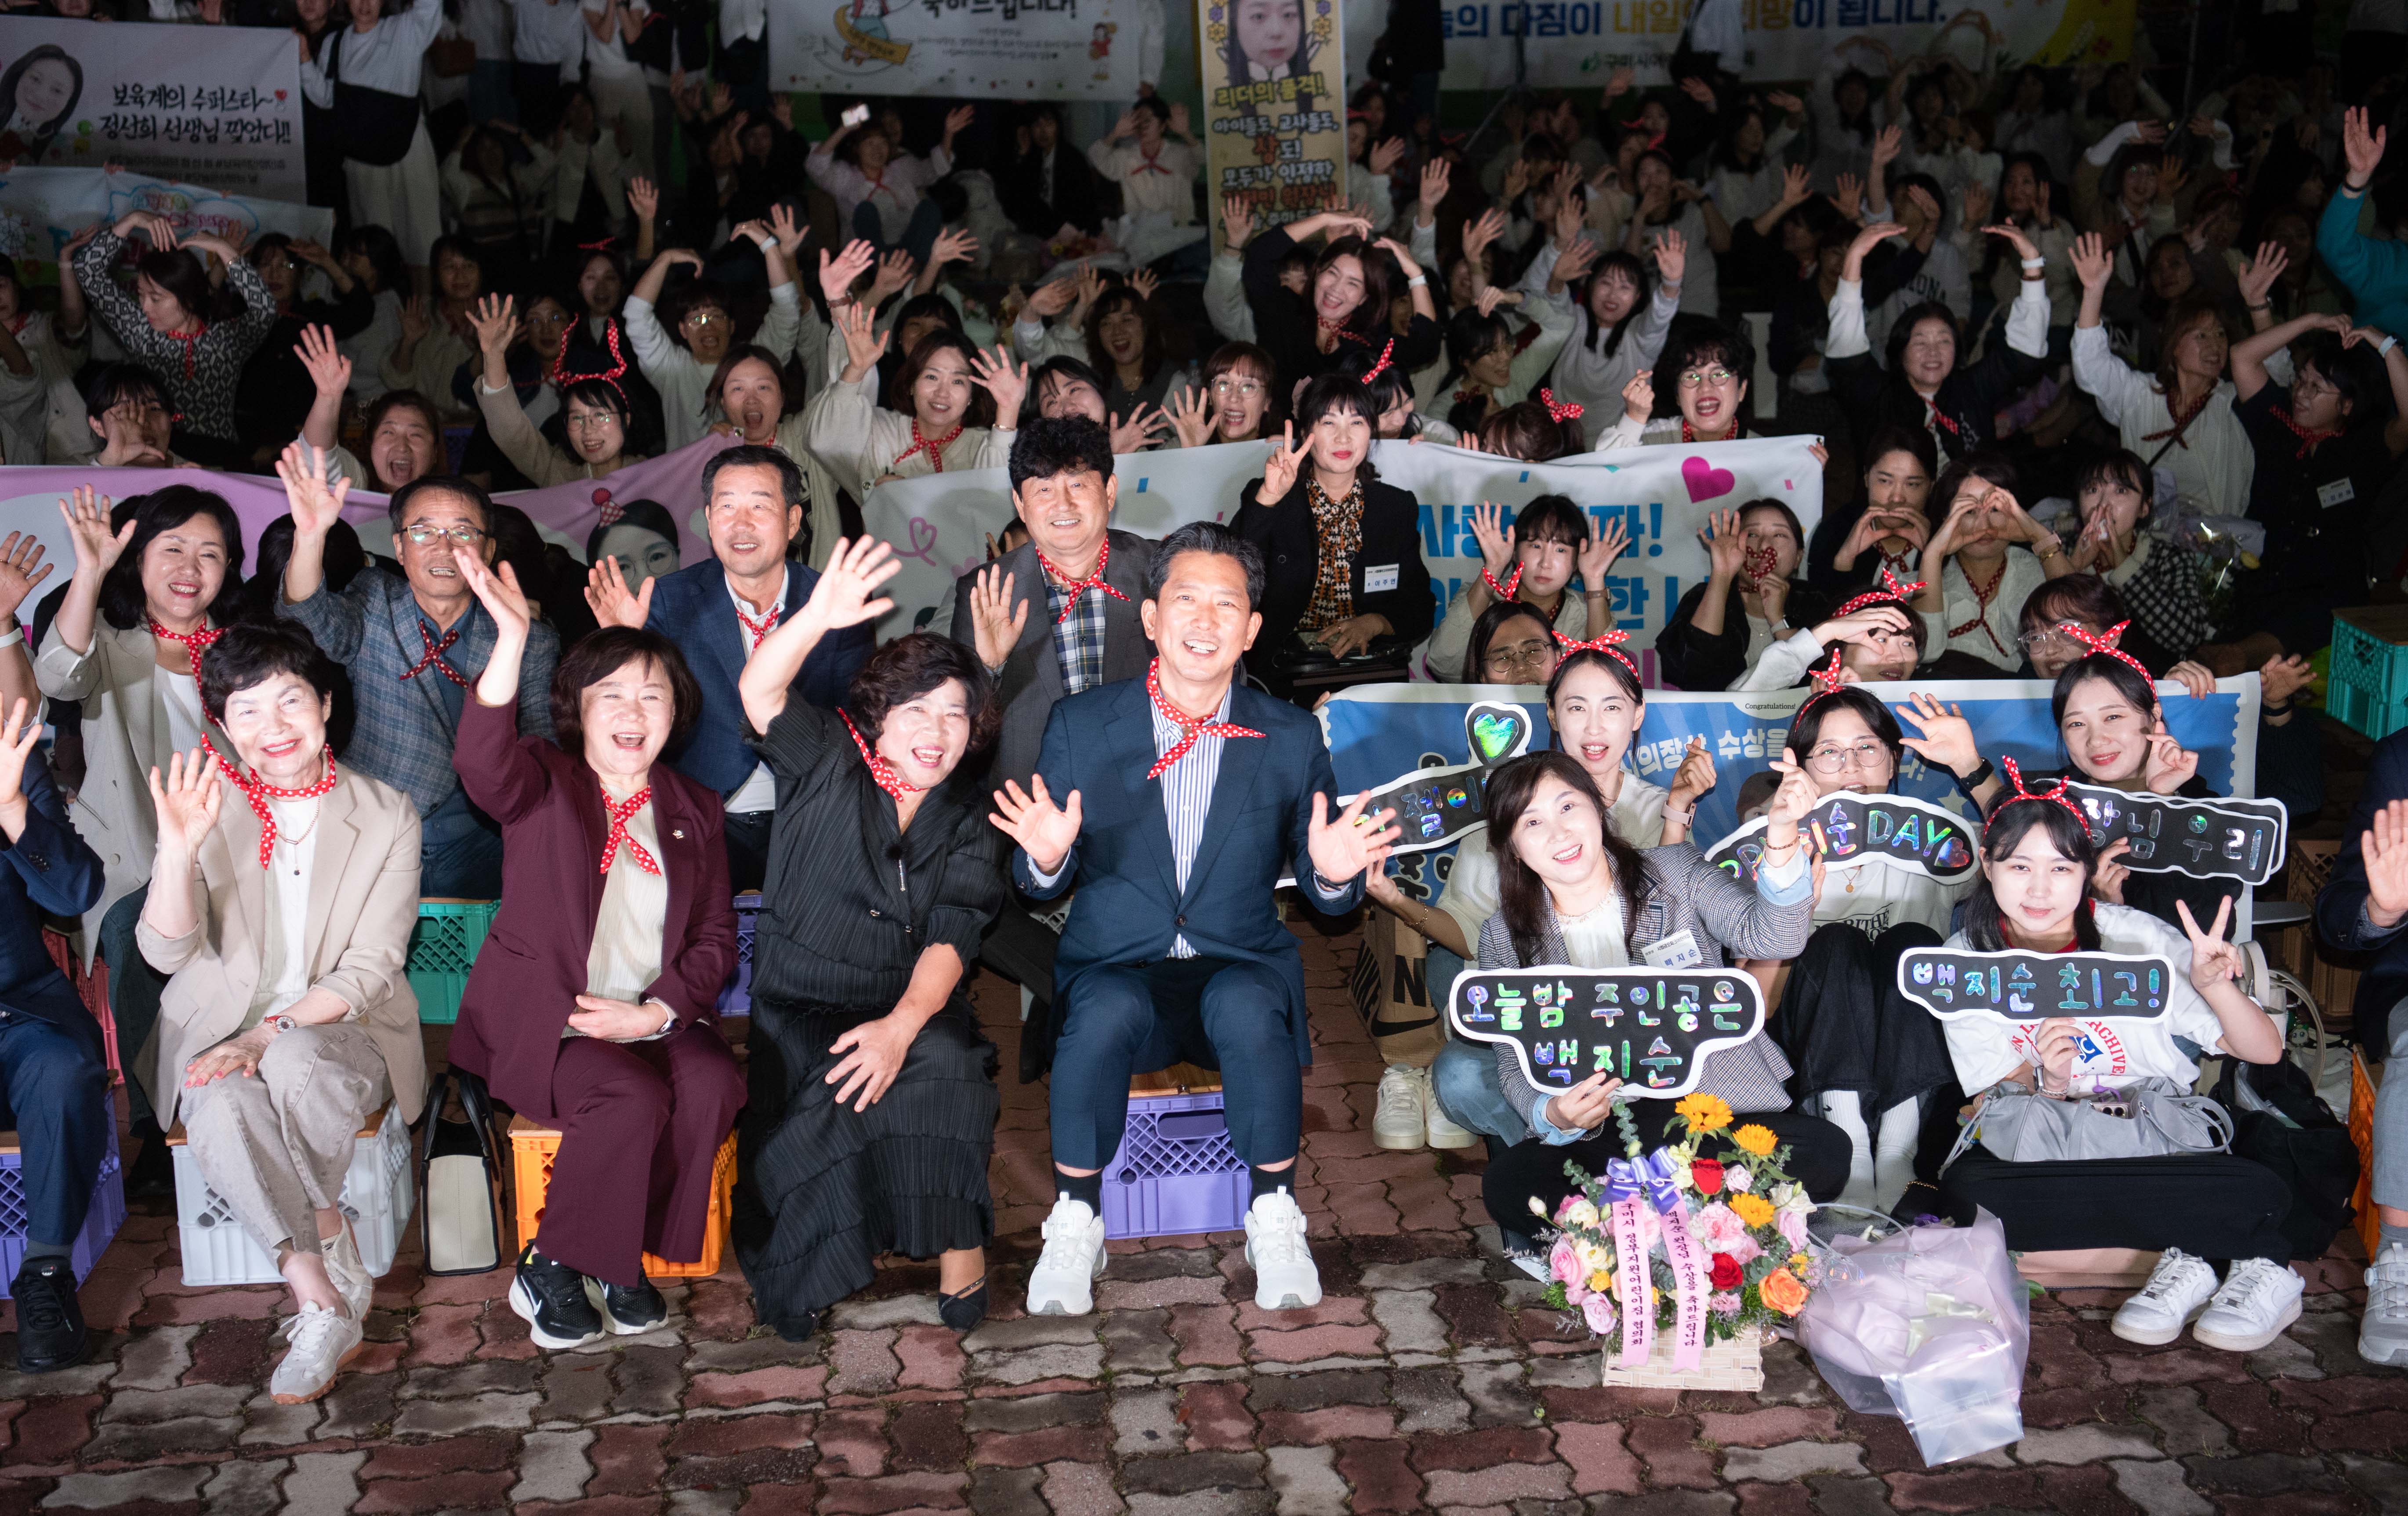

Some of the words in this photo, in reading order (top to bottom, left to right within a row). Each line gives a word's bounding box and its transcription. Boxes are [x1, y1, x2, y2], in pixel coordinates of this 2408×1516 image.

[113, 83, 185, 110] 보육계의
[1215, 81, 1275, 109] 리더의
[1279, 72, 1324, 102] 품격!
[100, 112, 157, 141] 정선희
[163, 115, 220, 143] 선생님
[1213, 115, 1277, 136] 아이들도,
[1279, 111, 1339, 133] 교사들도,
[1222, 164, 1274, 187] 모두가
[1277, 158, 1335, 185] 인정한
[1745, 702, 1796, 711] Congratulations!
[1718, 728, 1789, 760] 수상을
[1868, 809, 1952, 858] DAY
[2182, 813, 2263, 872] 우리
[1912, 962, 2037, 1013] 백지순
[2058, 962, 2161, 1010] 최고!
[1462, 980, 1573, 1031] 오늘밤
[1591, 980, 1742, 1032] 주인공은
[1621, 1203, 1636, 1228] 구미시
[1665, 1210, 1685, 1233] 백지순
[1672, 1236, 1690, 1259] 원장님
[1625, 1232, 1643, 1316] 정부지원어린이집
[1680, 1263, 1698, 1291] 수상을
[1631, 1320, 1643, 1347] 협의회
[1684, 1295, 1700, 1347] 축하드립니다
